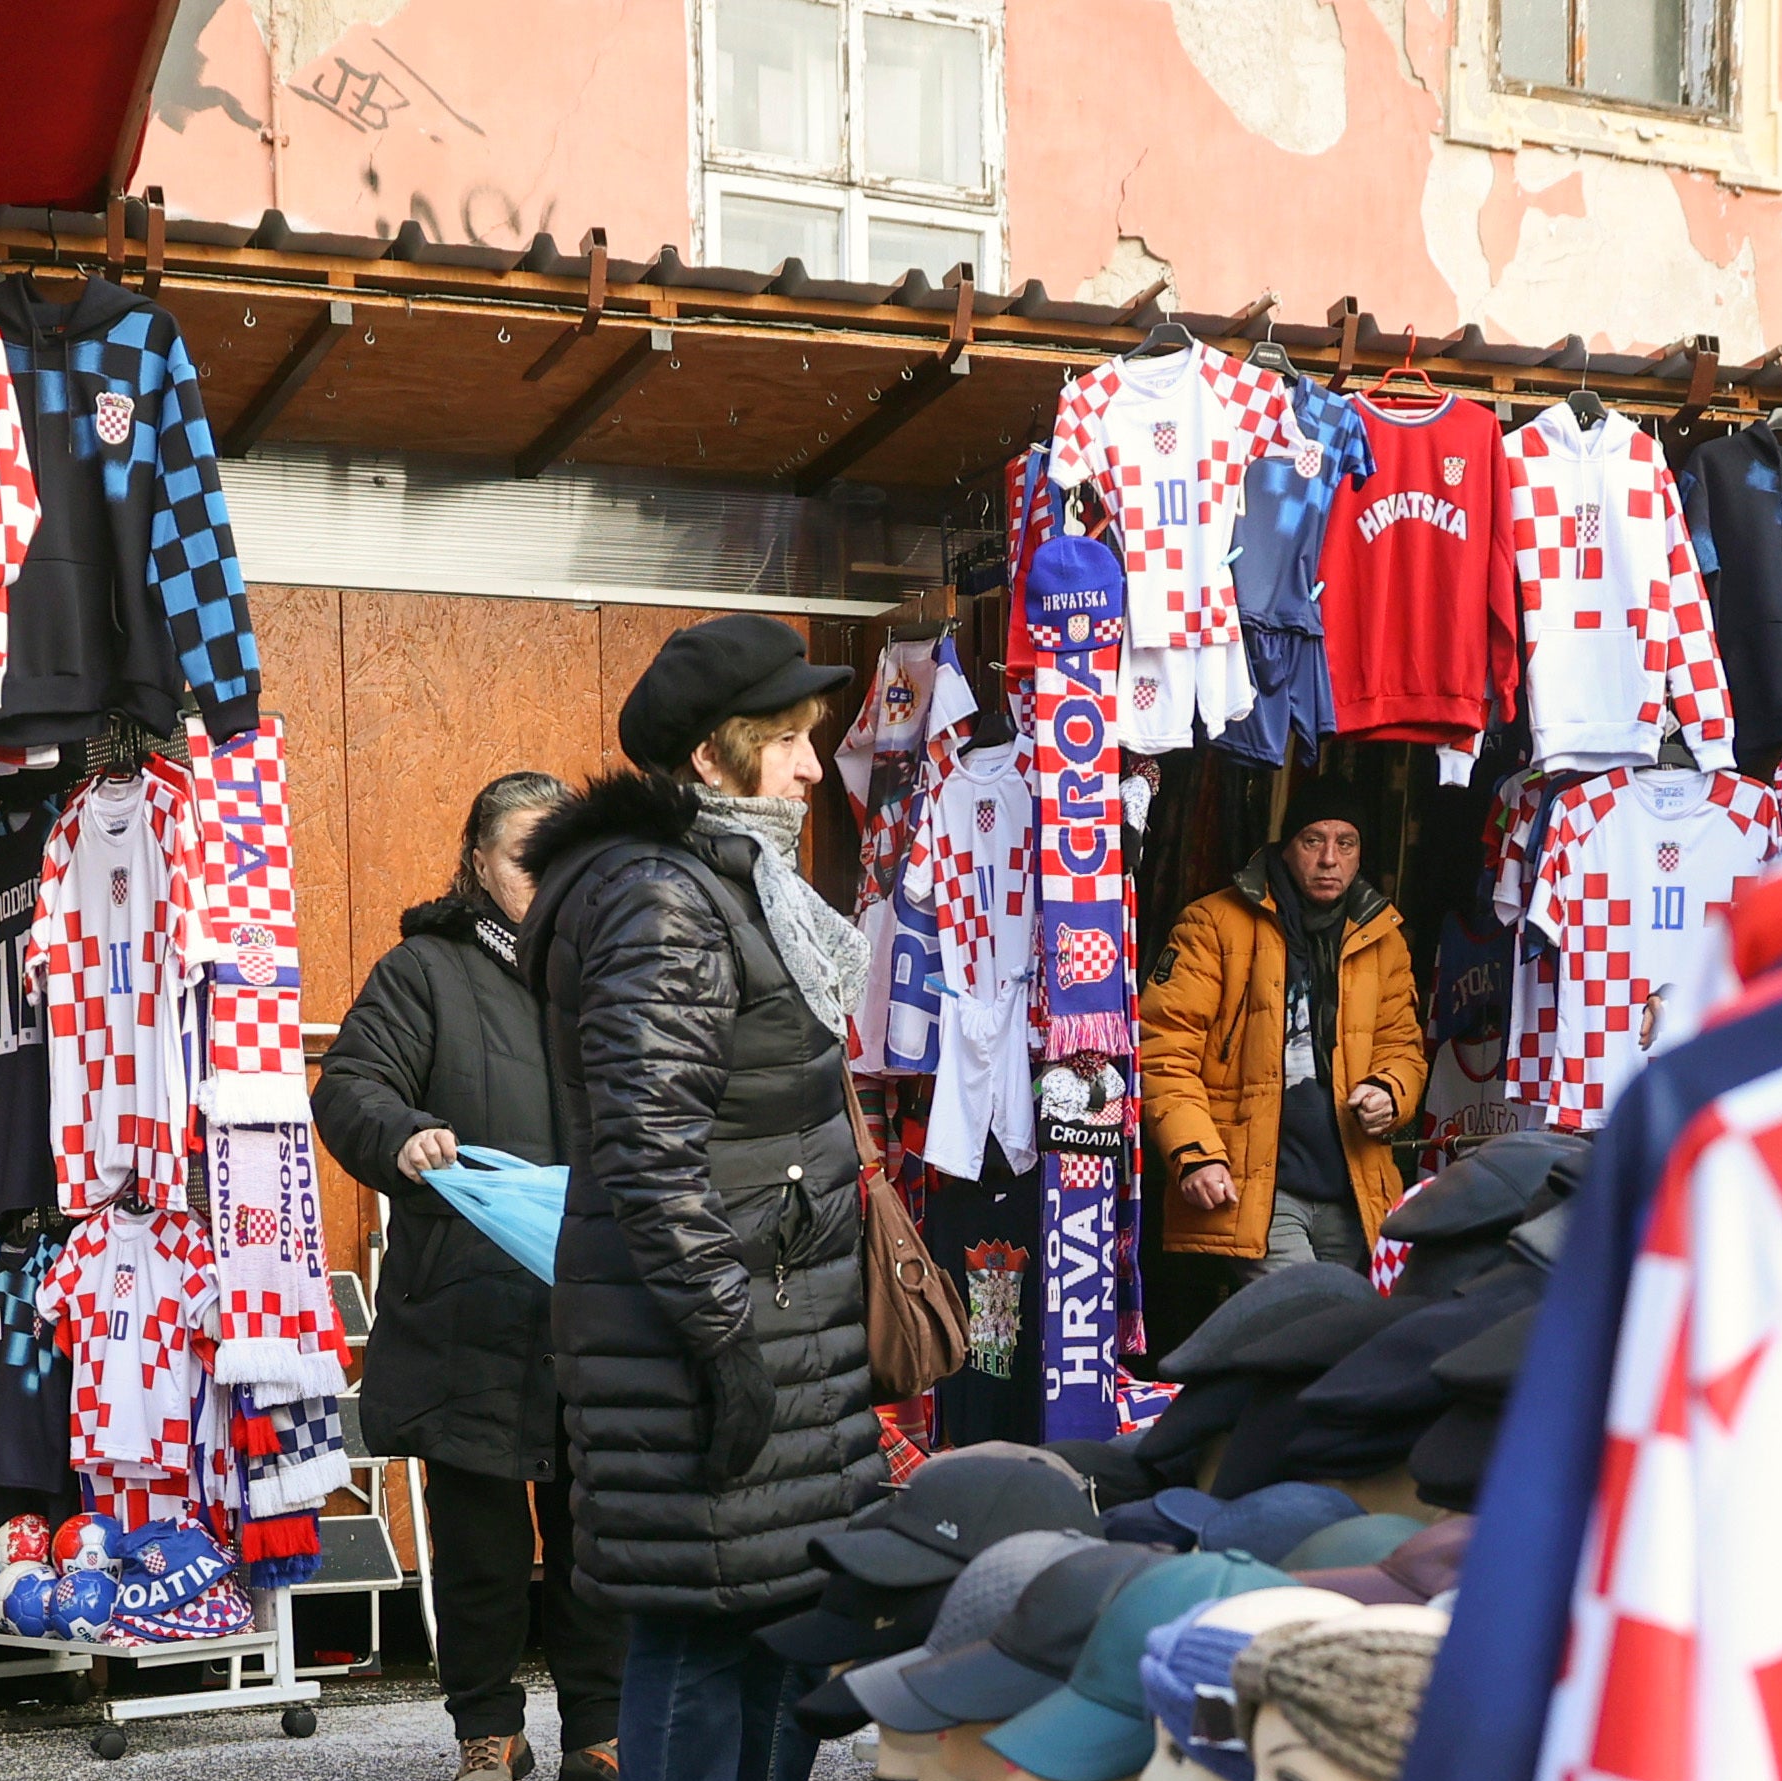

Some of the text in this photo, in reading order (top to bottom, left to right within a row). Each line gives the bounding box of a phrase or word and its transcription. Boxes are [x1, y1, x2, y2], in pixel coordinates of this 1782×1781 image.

[1154, 479, 1188, 526] 10
[1042, 589, 1108, 613] HRVATSKA
[1651, 886, 1686, 930] 10
[1050, 1124, 1121, 1148] CROATIA
[294, 1122, 322, 1278] PROUD
[1046, 1187, 1061, 1313] BOJ
[1062, 1203, 1098, 1385] HRVA
[107, 1309, 130, 1341] 10
